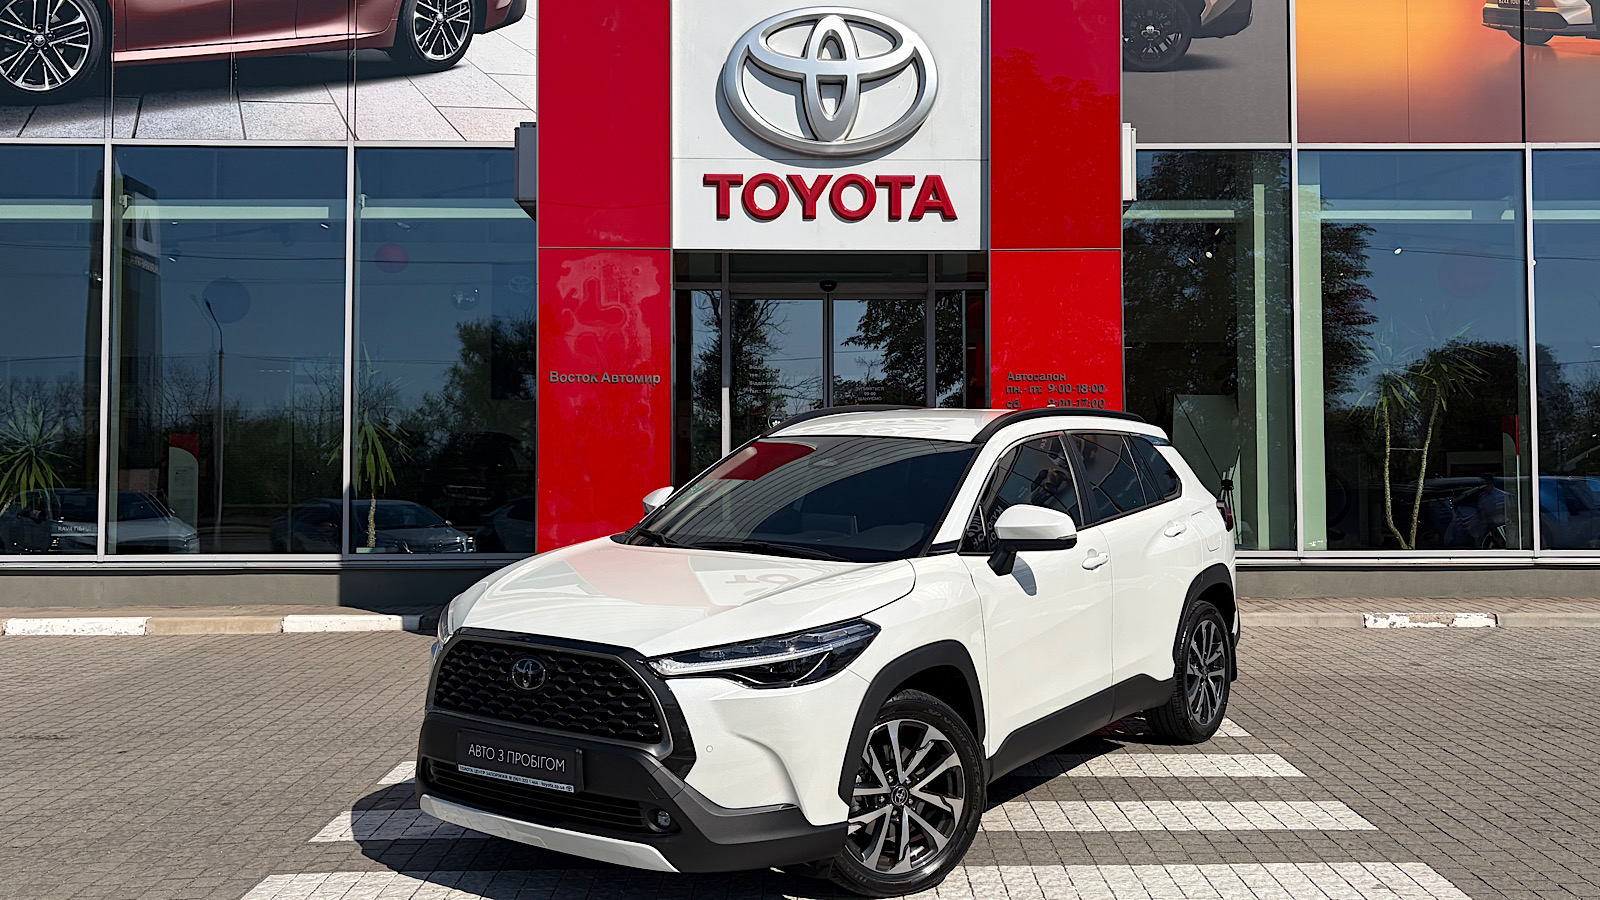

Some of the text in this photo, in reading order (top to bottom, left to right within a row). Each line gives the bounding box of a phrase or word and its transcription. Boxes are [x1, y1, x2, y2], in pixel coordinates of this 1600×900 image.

[703, 173, 958, 222] TOYOTA
[549, 371, 661, 387] Восток Автомир
[1007, 371, 1067, 382] Автосалон
[1047, 383, 1106, 394] 9:00-18:00
[468, 743, 495, 760] АВТО
[506, 750, 565, 773] ПРОБІГОМ
